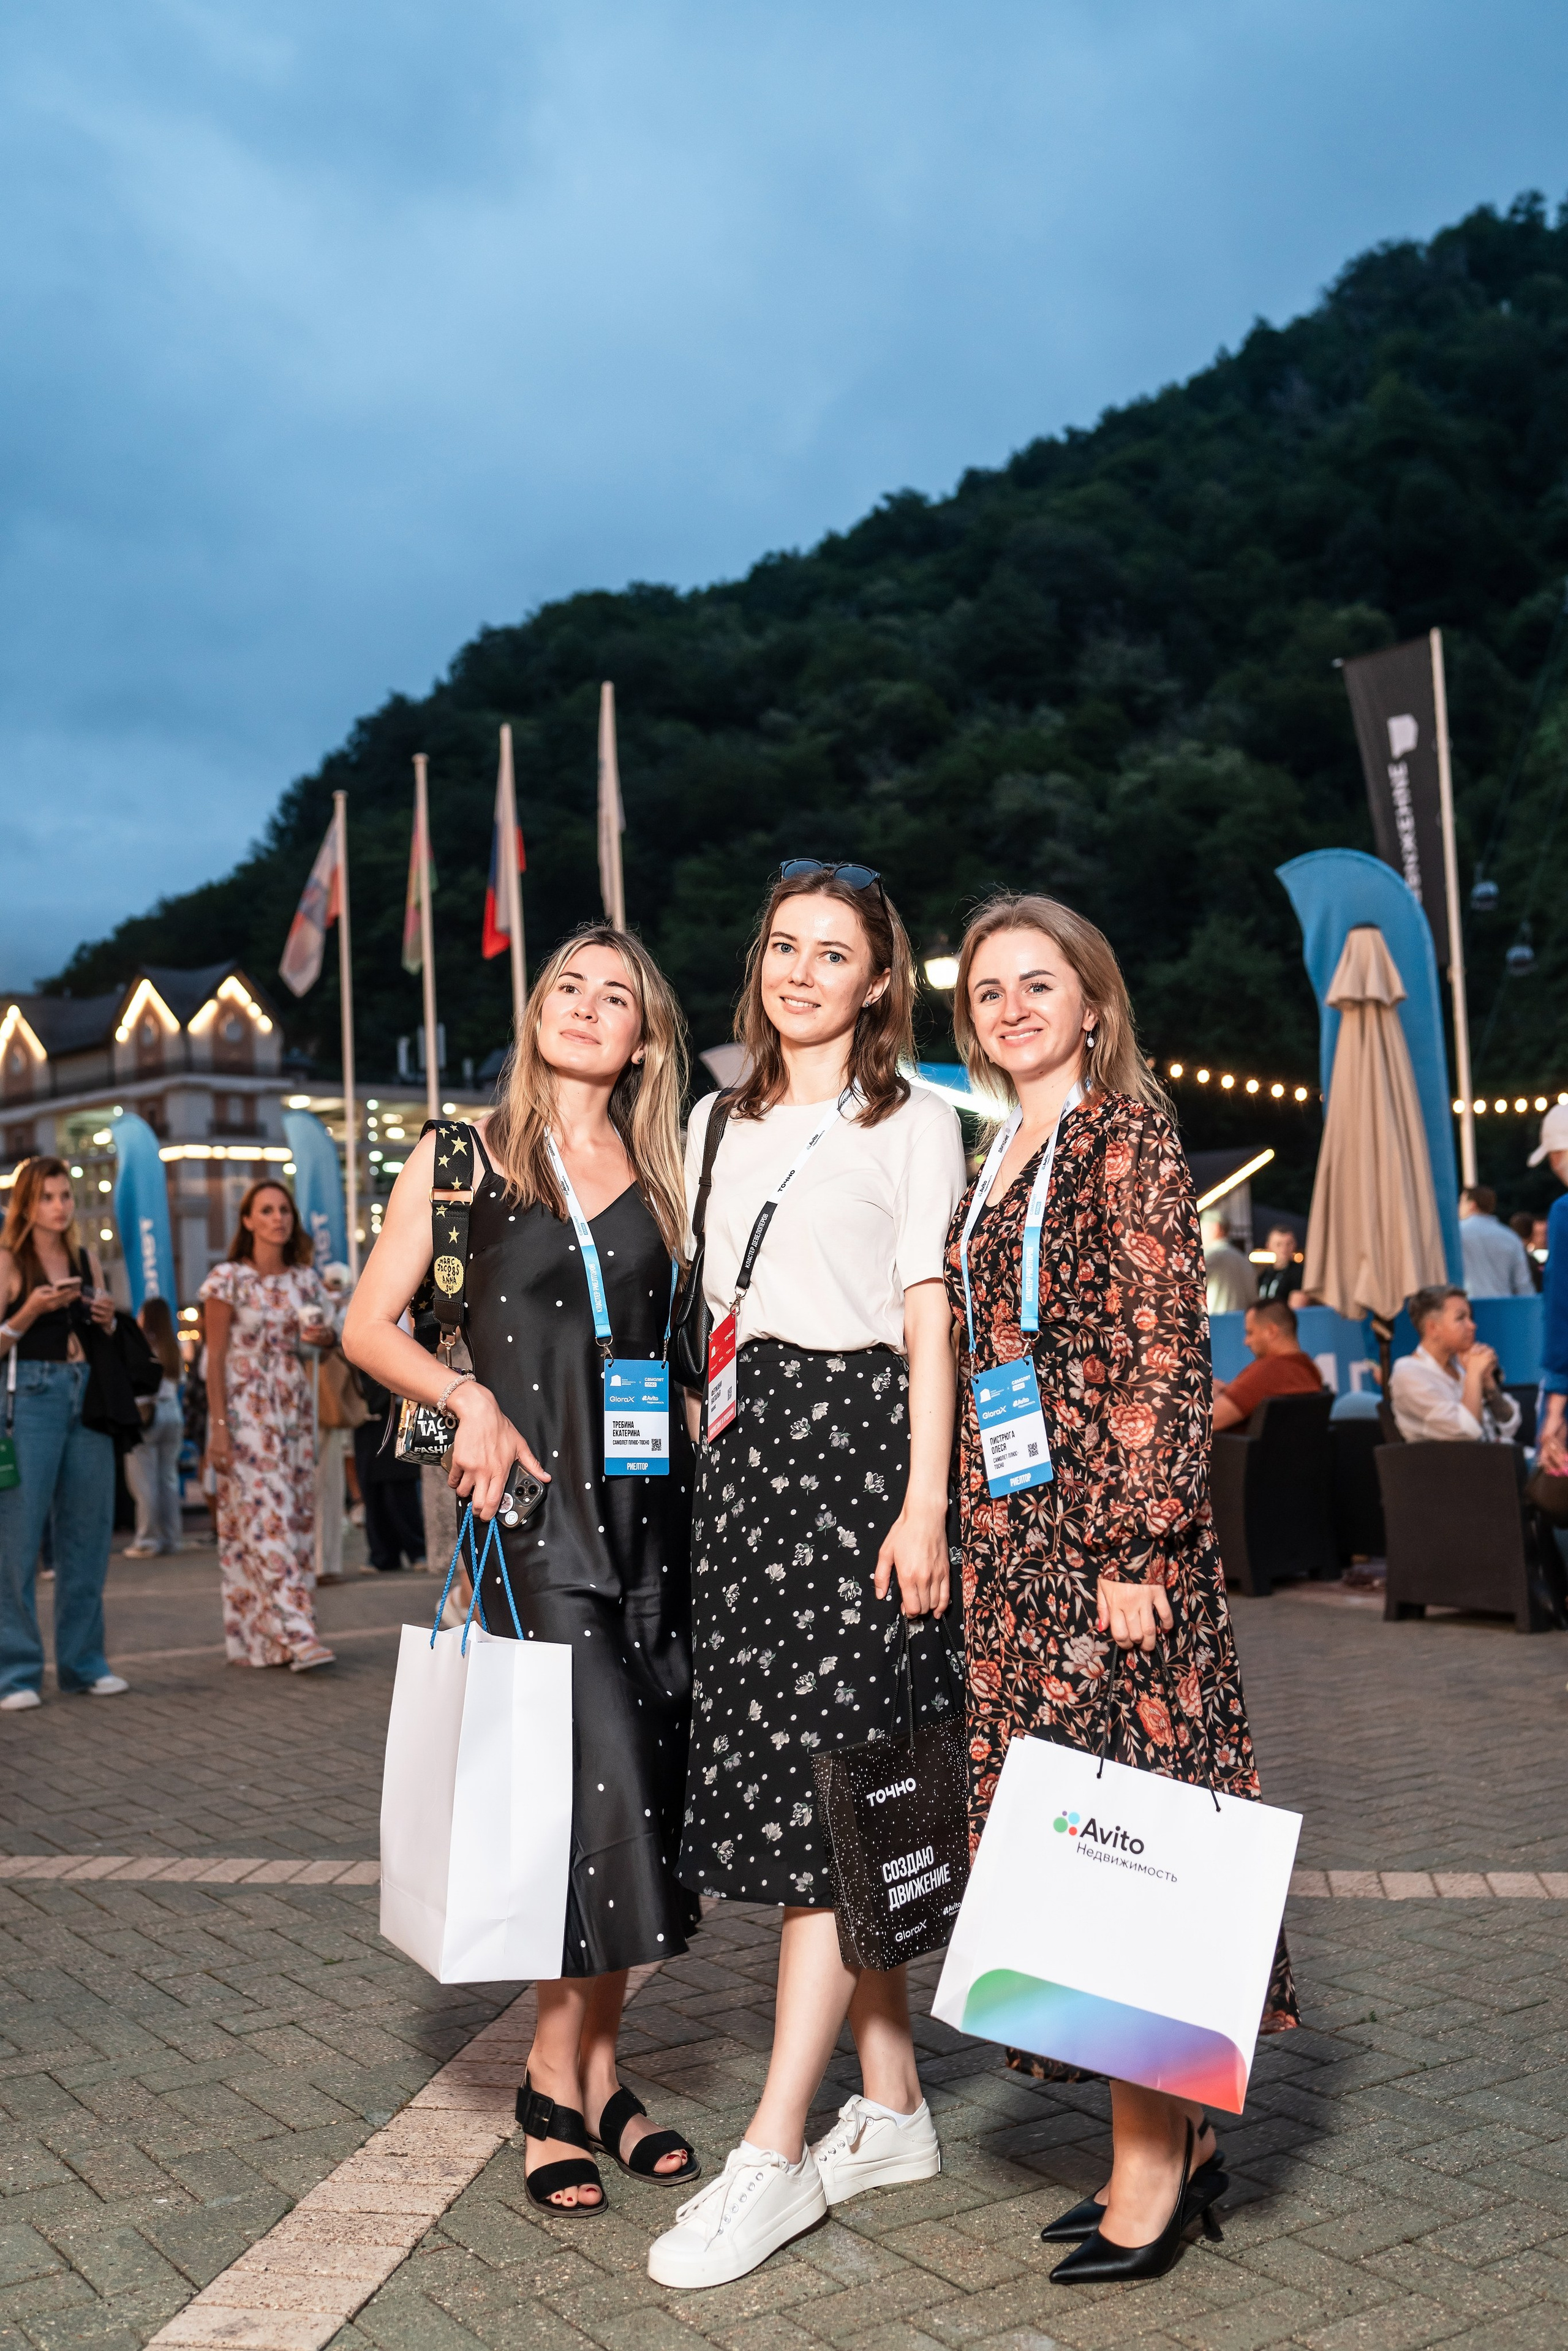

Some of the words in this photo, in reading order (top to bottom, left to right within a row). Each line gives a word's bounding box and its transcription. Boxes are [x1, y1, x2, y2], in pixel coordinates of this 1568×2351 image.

[998, 1134, 1009, 1153] ДВИЖЕНИЕ
[777, 1170, 795, 1192] ТОЧНО
[745, 1247, 756, 1269] КЛАСТЕР
[752, 1213, 769, 1247] ДЕВЕЛОПЕРОВ
[437, 1264, 459, 1276] JACOBS
[442, 1275, 456, 1285] ANNA
[589, 1263, 600, 1291] РИЕЛТОРОВ
[594, 1291, 603, 1313] КЛАСТЕР
[982, 1405, 1007, 1420] GloraX
[990, 1430, 1016, 1446] ПИСТРЮГА
[414, 1444, 452, 1454] FASHI
[991, 1443, 1007, 1455] ОЛЕСЯ
[993, 1454, 1008, 1463] САМОЛЕТ
[1009, 1473, 1031, 1487] РИЕЛТОР
[866, 1777, 916, 1807] ТОЧНО
[1079, 1817, 1145, 1855] Avito
[882, 1845, 935, 1884] СОЗДАЮ
[1076, 1842, 1177, 1882] Недвижимость
[888, 1862, 951, 1912] ДВИЖЕНИЕ
[949, 1902, 961, 1912] Avito
[895, 1919, 927, 1942] GloraX
